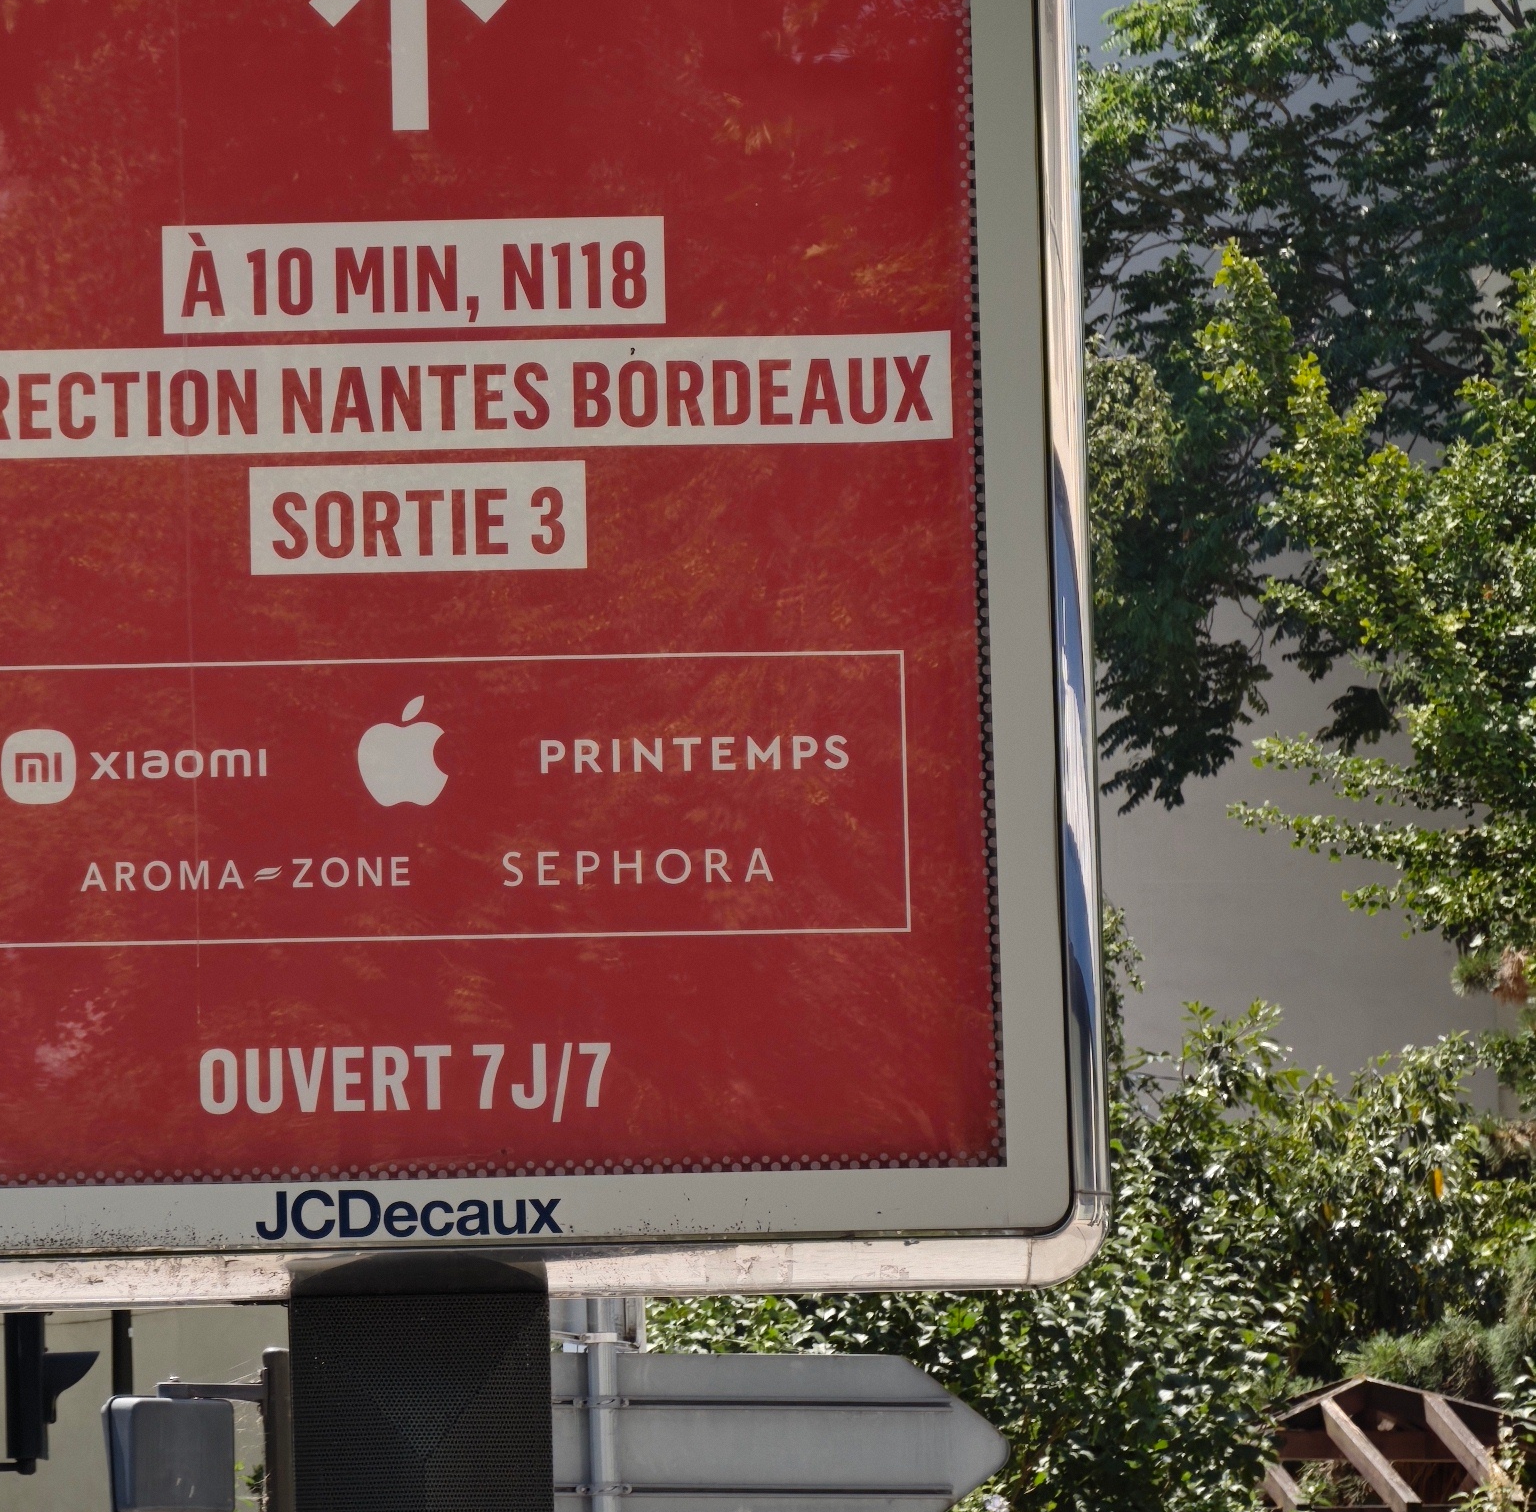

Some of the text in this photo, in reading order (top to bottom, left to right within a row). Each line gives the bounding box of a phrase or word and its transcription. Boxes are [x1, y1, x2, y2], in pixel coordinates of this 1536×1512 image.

[181, 232, 648, 324] À 10 MIN, N118
[281, 360, 550, 435] NANTES
[571, 353, 935, 430] BORDEAUX
[271, 486, 566, 561] SORTIE 3
[540, 734, 850, 774] PRINTEMPS
[502, 847, 774, 887] SEPHORA
[199, 1042, 612, 1123] OUVERT 7J/7
[255, 1189, 563, 1241] JCDecaux
